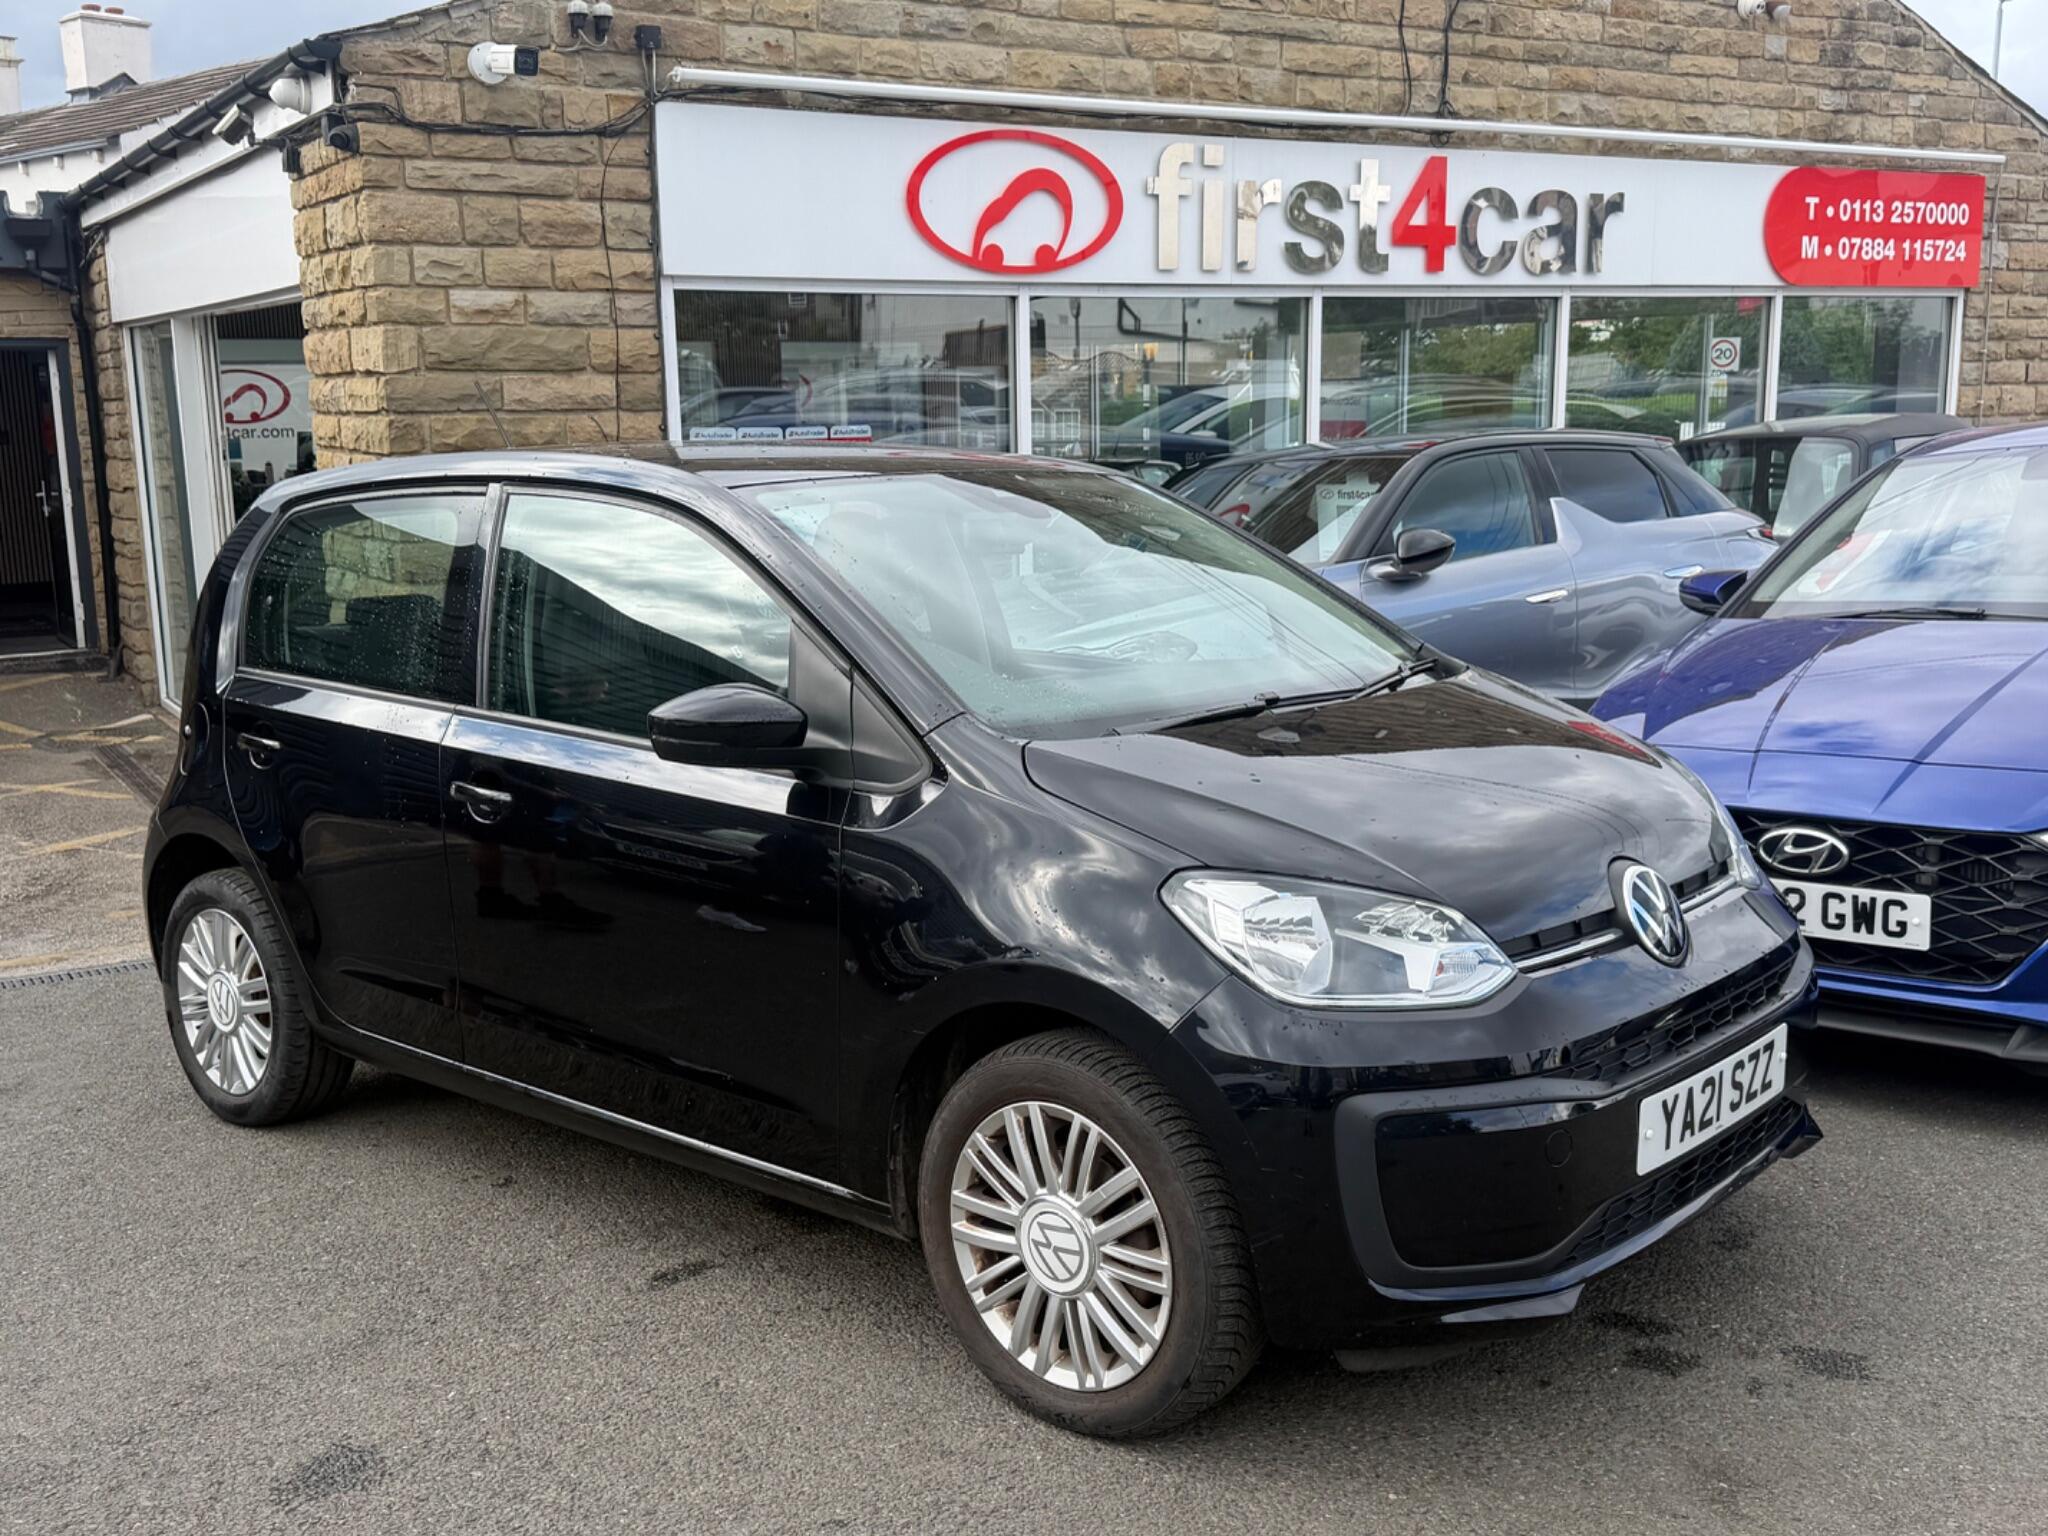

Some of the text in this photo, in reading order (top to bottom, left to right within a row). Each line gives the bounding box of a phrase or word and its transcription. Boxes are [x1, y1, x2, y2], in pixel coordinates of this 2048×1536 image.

[1146, 143, 1625, 275] first4car
[1804, 196, 1970, 226] T 0113 2570000
[1801, 235, 1967, 262] M 07884 115724
[1714, 347, 1733, 360] 20
[1820, 891, 1908, 939] GWG
[1661, 1038, 1775, 1151] YA21 SZZ
